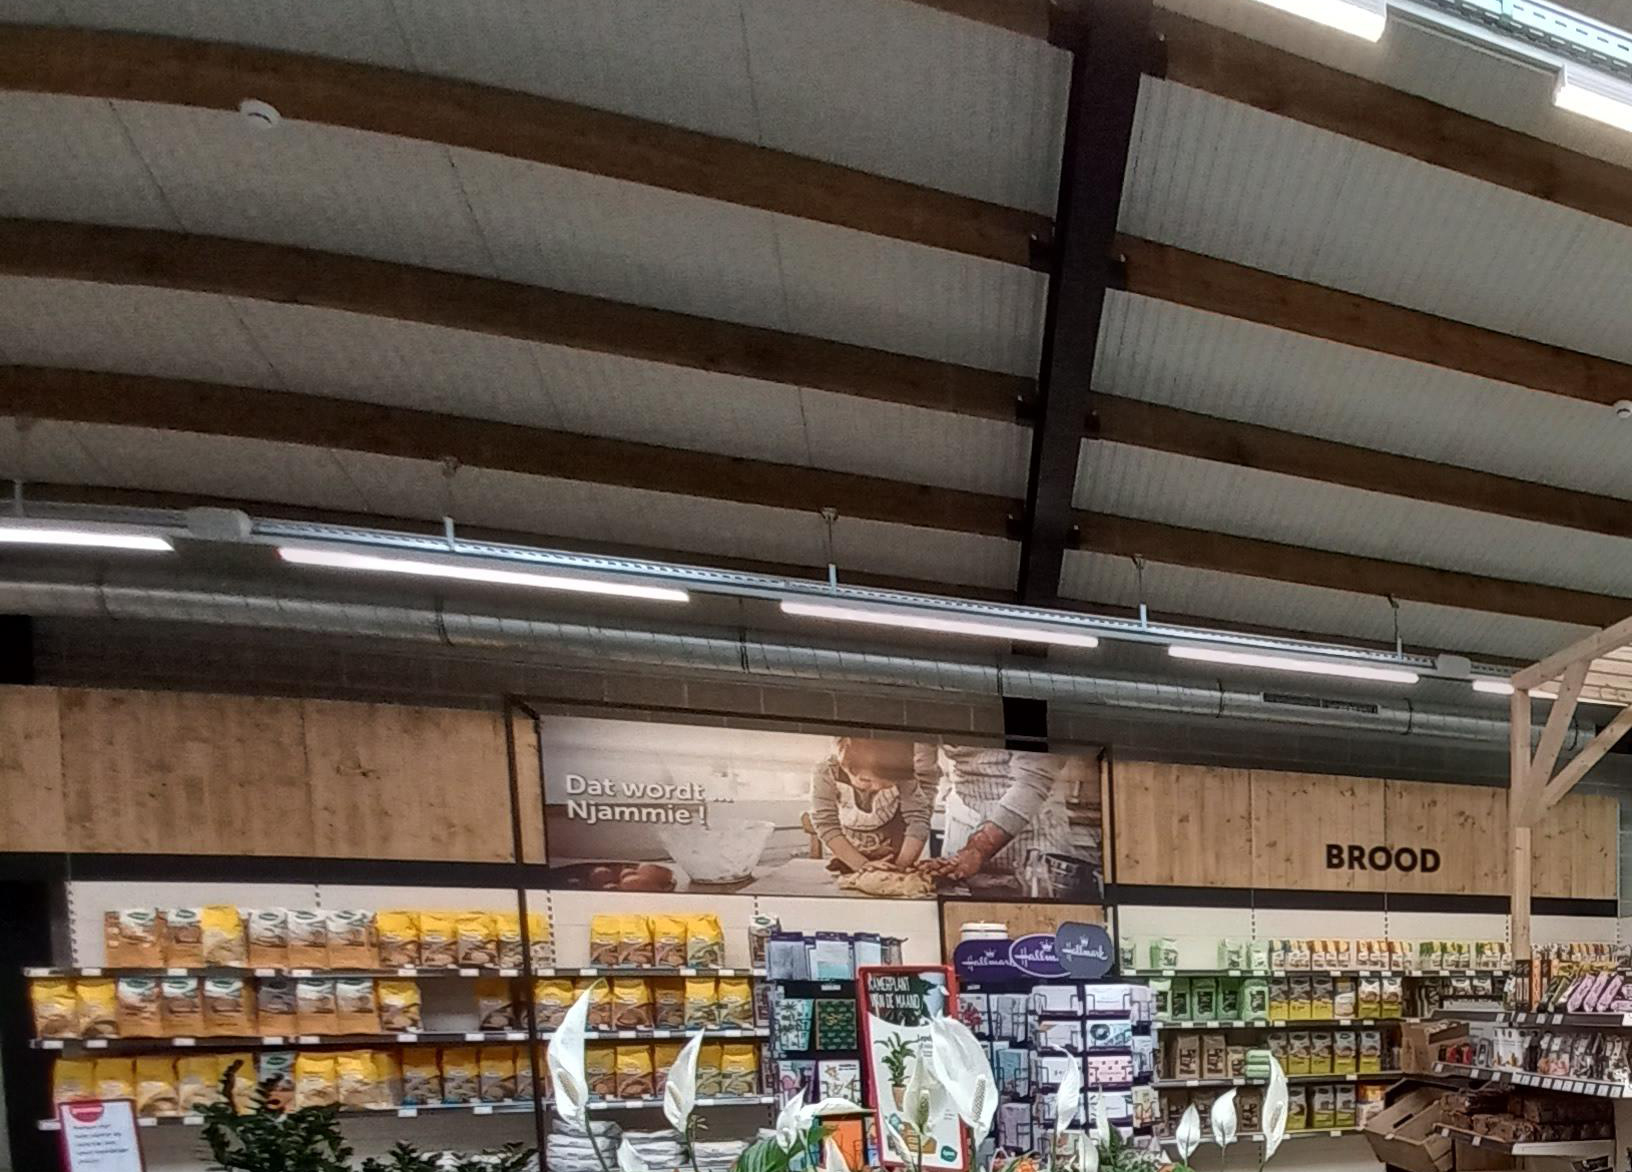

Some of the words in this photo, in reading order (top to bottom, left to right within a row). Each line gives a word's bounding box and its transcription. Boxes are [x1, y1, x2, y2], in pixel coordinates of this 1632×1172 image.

[565, 774, 616, 796] Dat
[622, 781, 706, 801] wordt
[566, 799, 693, 825] Njammie
[1325, 843, 1441, 873] BROOD
[1061, 940, 1109, 962] Hallmark
